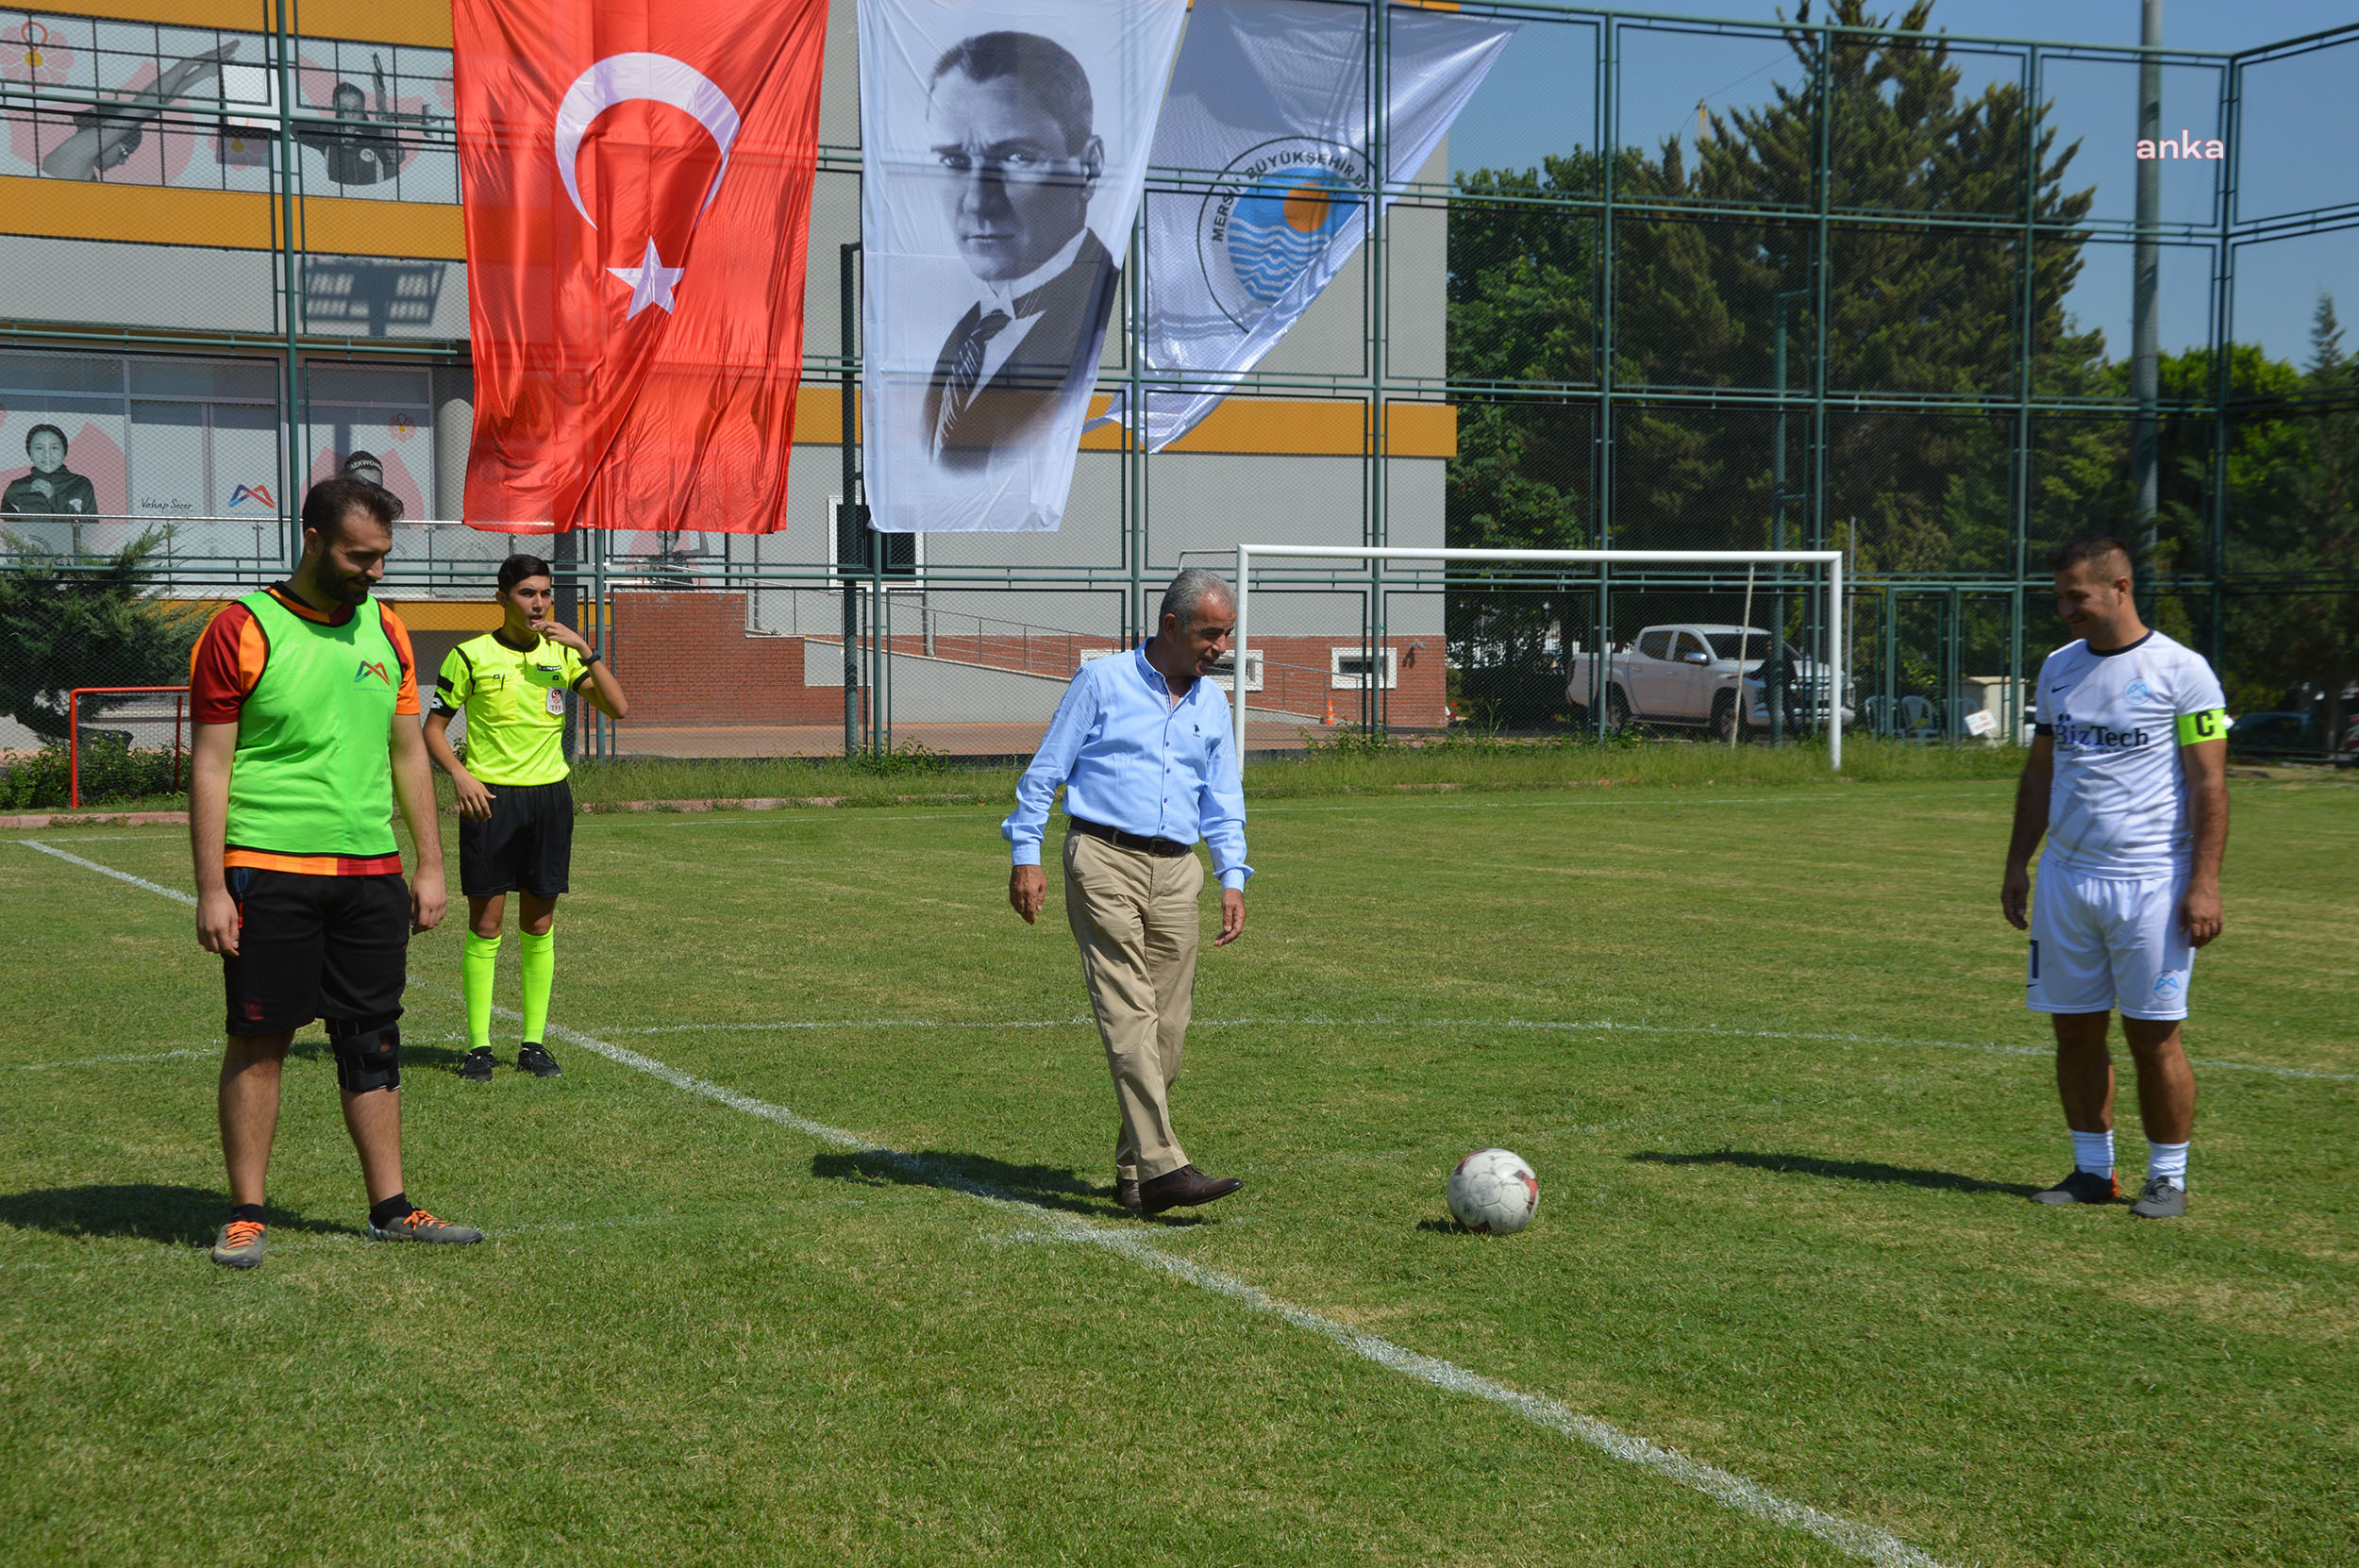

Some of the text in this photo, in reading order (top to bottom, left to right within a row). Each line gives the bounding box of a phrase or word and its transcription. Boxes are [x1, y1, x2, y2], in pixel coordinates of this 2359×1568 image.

[1245, 150, 1355, 180] BÜYÜKŞEHİR
[141, 496, 169, 514] Vahap
[2054, 724, 2150, 746] BizTech
[2196, 710, 2214, 736] C
